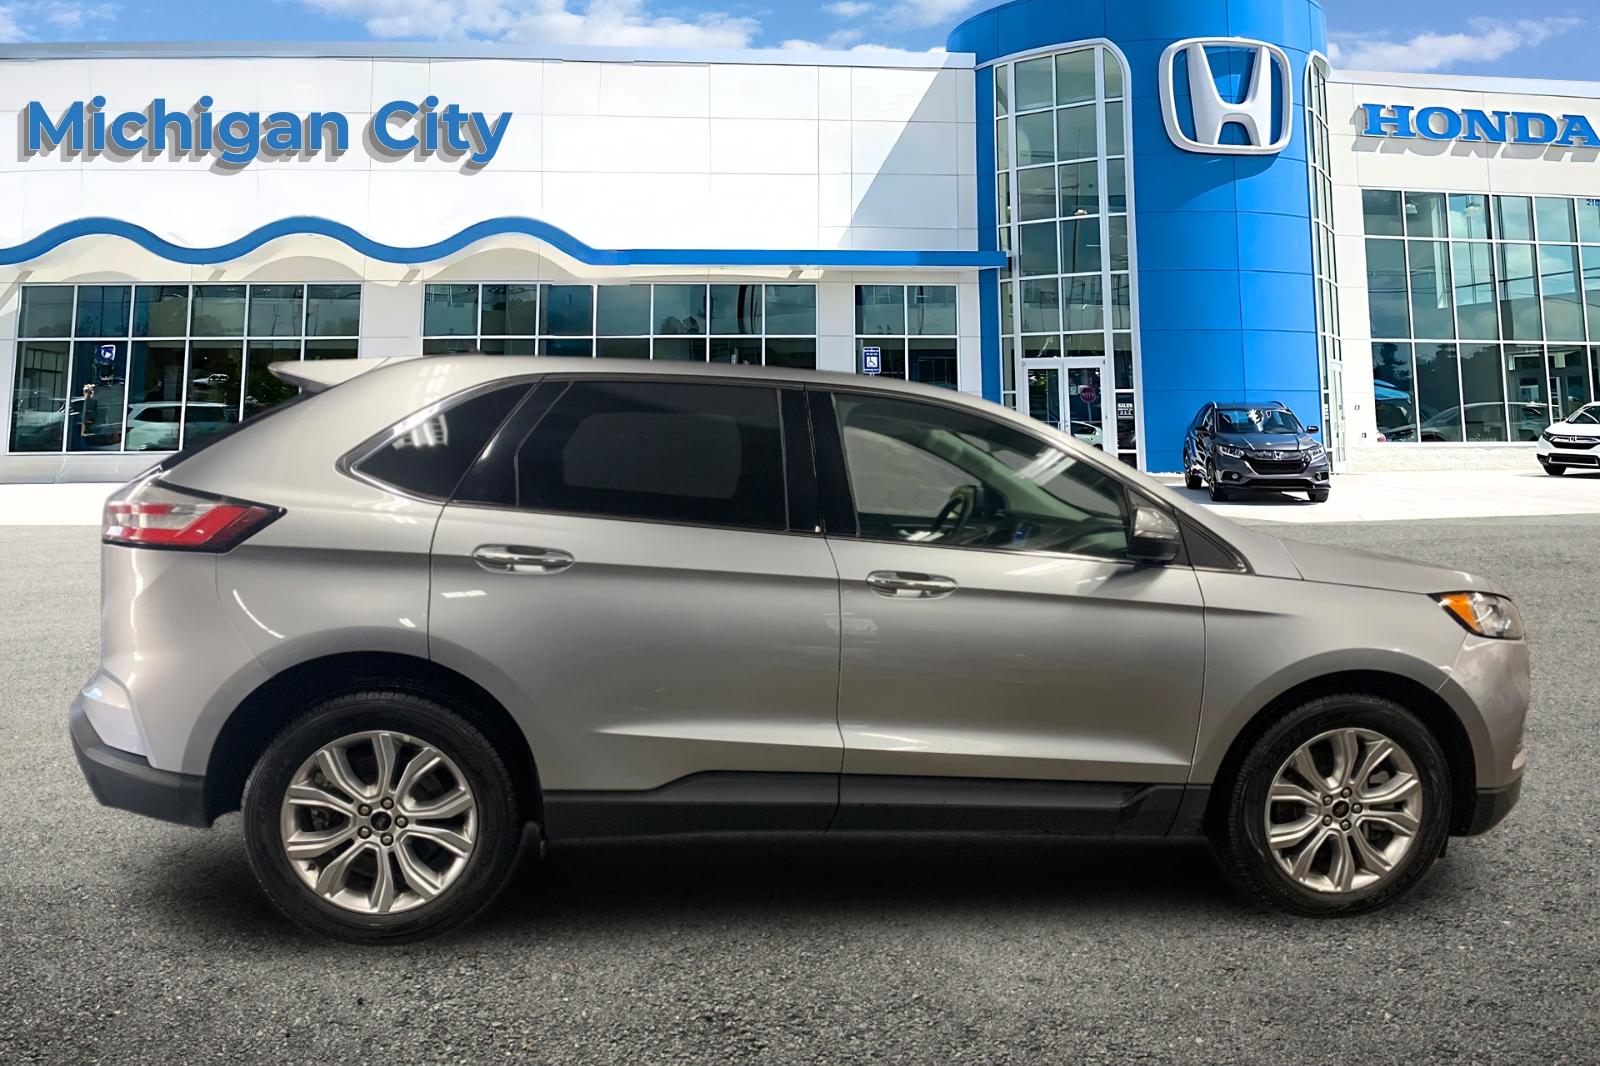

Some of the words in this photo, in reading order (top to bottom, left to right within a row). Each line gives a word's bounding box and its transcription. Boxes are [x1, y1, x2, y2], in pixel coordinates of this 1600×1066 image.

[27, 95, 350, 163] Michigan
[373, 95, 513, 163] City
[1361, 103, 1600, 147] HONDA
